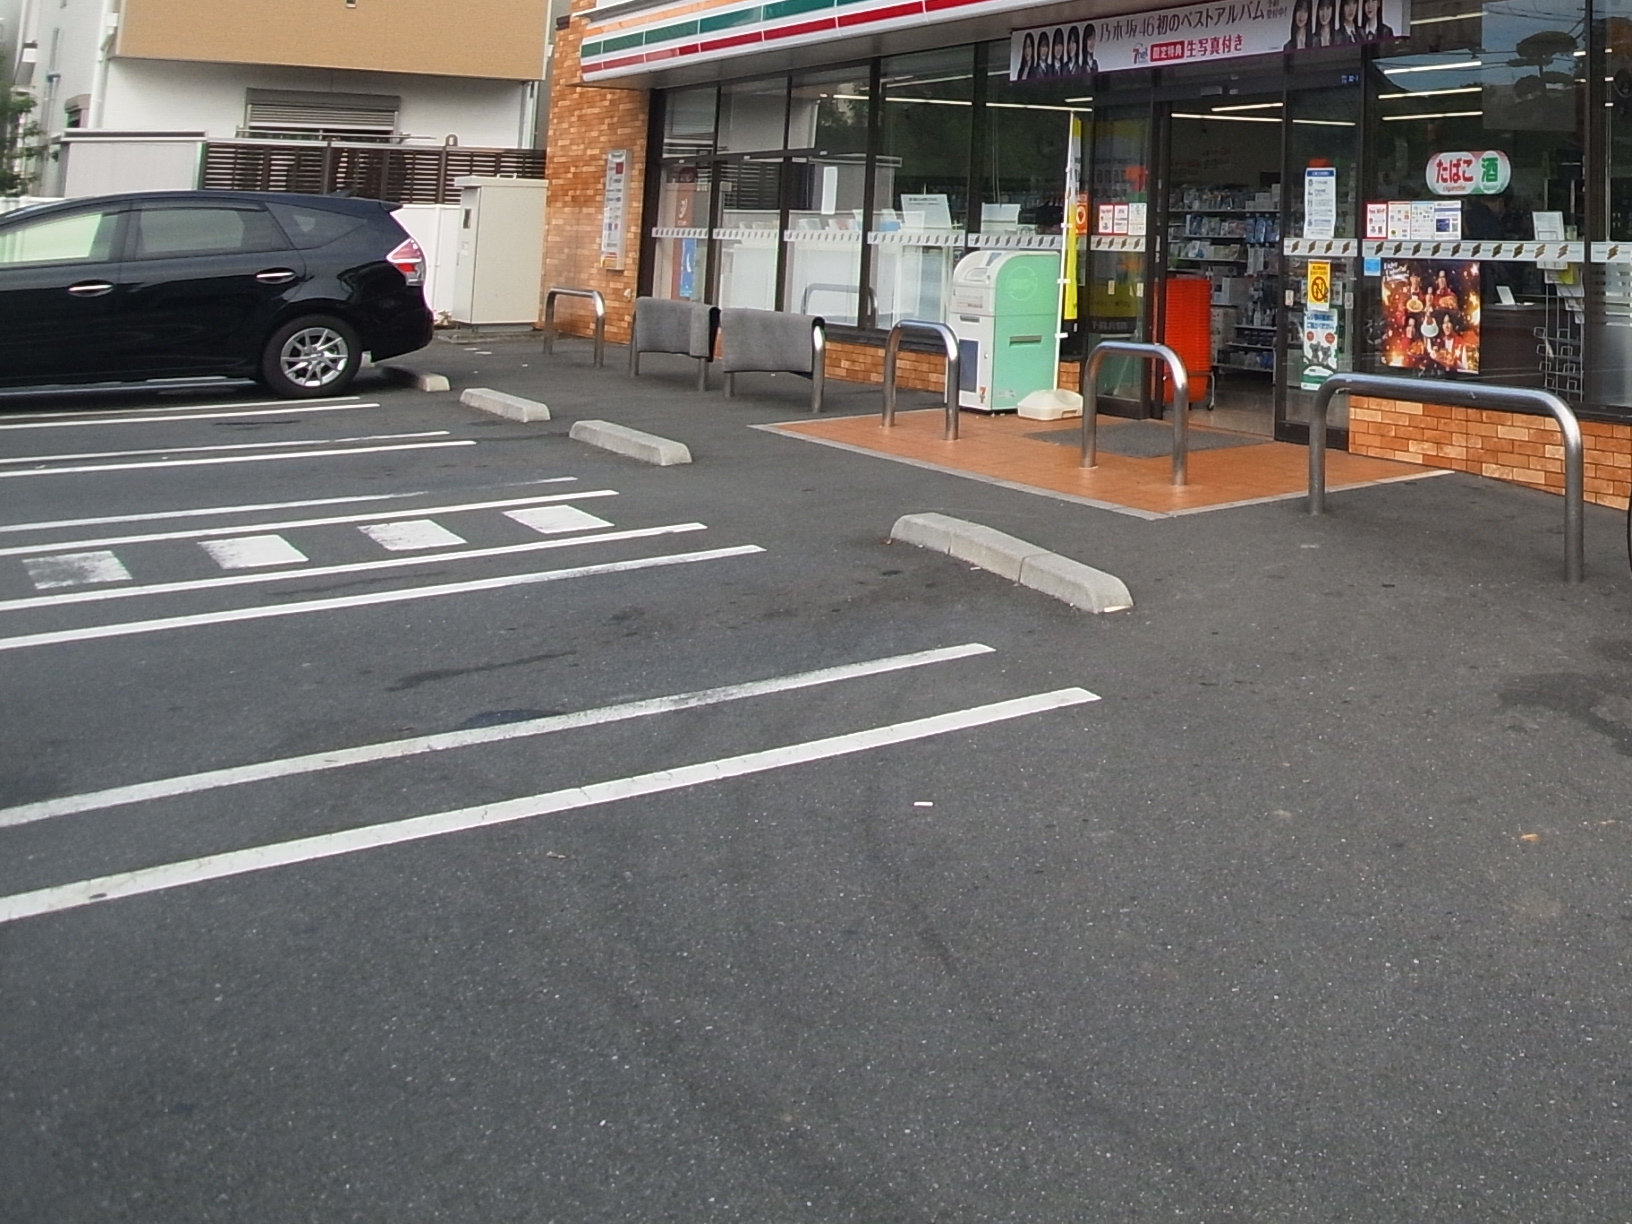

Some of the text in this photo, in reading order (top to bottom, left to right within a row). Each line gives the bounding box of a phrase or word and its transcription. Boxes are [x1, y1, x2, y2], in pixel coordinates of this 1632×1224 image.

[1186, 34, 1243, 58] 生写真付き
[1436, 157, 1499, 184] たばこ 酒
